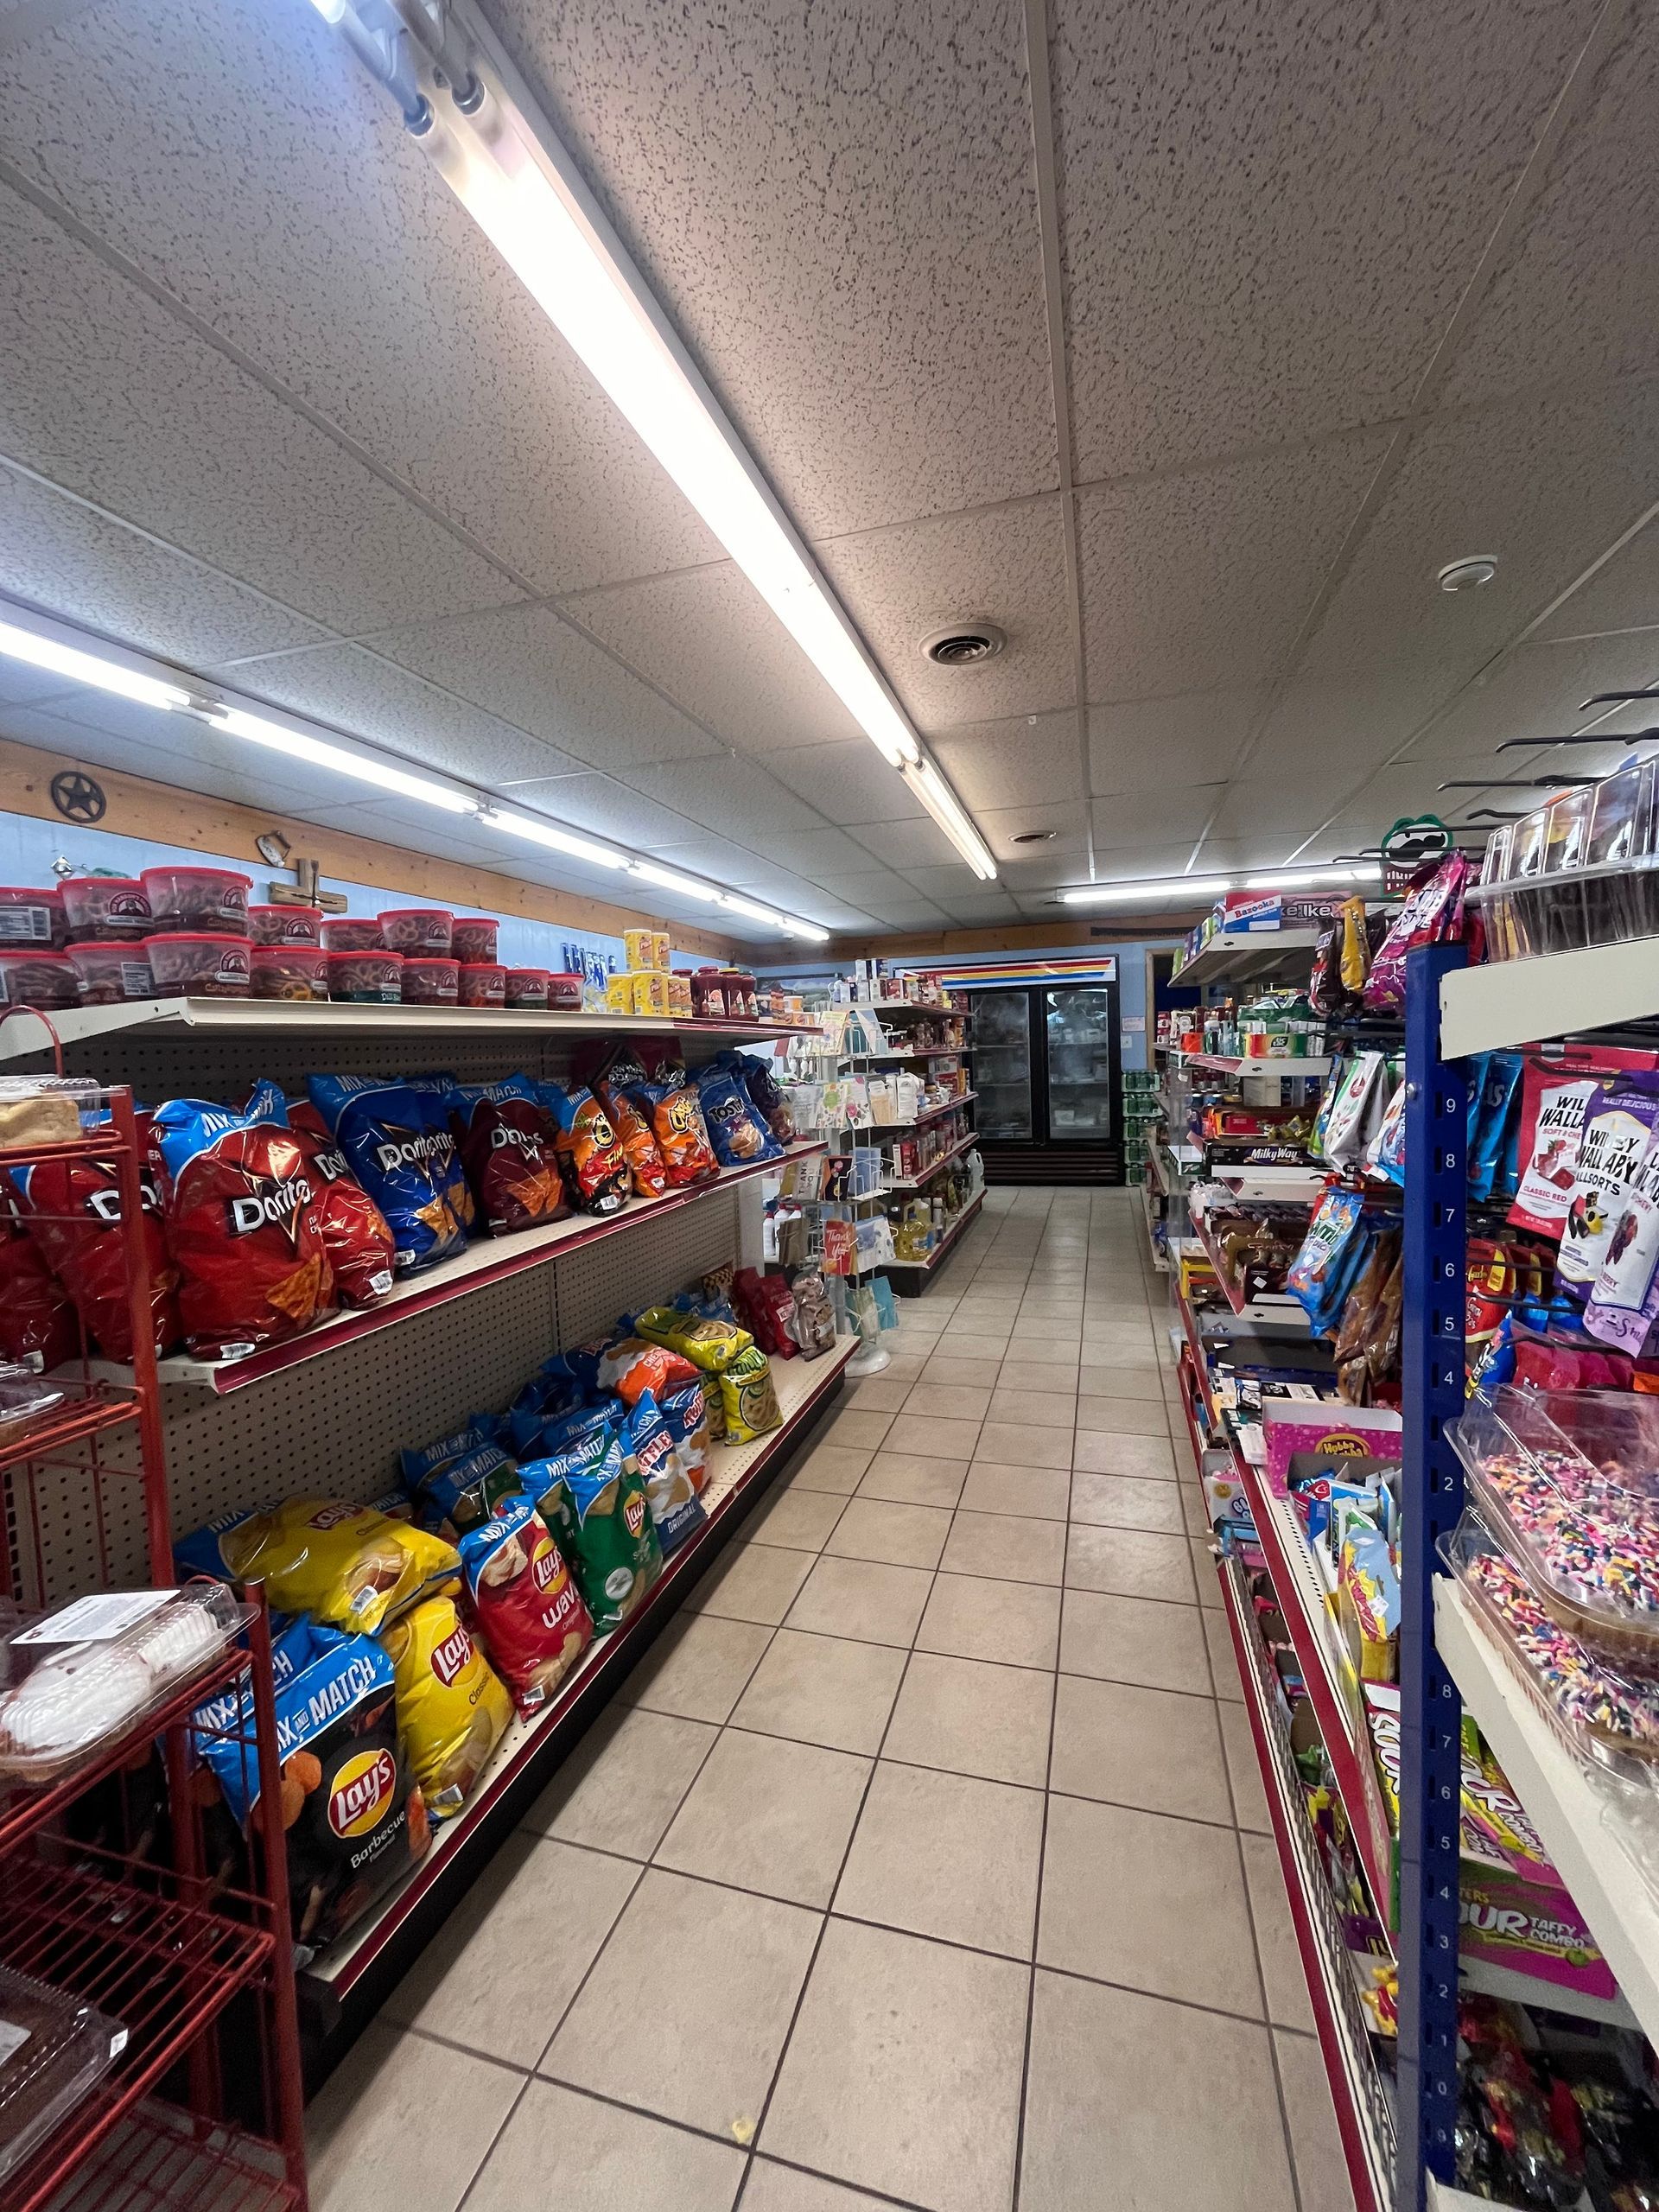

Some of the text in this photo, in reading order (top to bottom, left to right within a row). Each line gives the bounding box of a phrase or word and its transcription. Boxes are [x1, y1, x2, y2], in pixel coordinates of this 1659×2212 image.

[1234, 899, 1275, 918] Bazooka
[334, 1075, 367, 1092] MIX
[1446, 1098, 1456, 1113] 9
[1555, 1096, 1586, 1111] WIL
[1539, 1109, 1586, 1128] WALLA
[1567, 1130, 1582, 1140] CHE
[377, 1134, 434, 1171] Dorito
[313, 1149, 347, 1181] Dori
[1446, 1154, 1456, 1169] 8
[798, 1160, 809, 1195] THANK
[1523, 1185, 1568, 1203] CLASSIC RED
[232, 1179, 313, 1232] Dorito
[1446, 1208, 1456, 1223] 7
[826, 1229, 851, 1243] Thank
[1445, 1262, 1455, 1277] 6
[1445, 1316, 1455, 1332] 5
[1444, 1370, 1453, 1385] 4
[424, 1440, 451, 1462] MIX
[545, 1458, 570, 1479] MIX
[1444, 1477, 1453, 1491] 2
[666, 1503, 697, 1535] ORIGINAL
[308, 1654, 378, 1726] MATCH
[1442, 1684, 1452, 1699] 8
[1442, 1735, 1452, 1750] 7
[338, 1754, 391, 1830] Lay's
[1441, 1785, 1452, 1801] 6
[350, 1810, 407, 1869] Barbecue
[1440, 1835, 1451, 1850] 5
[1440, 1885, 1451, 1900] 4
[1529, 1916, 1578, 1936] TAFFY
[1440, 1935, 1449, 1949] 3
[1529, 1929, 1586, 1949] COMBO
[1439, 1985, 1448, 1999] 2
[1440, 2034, 1447, 2047] 1
[1438, 2081, 1447, 2095] 0
